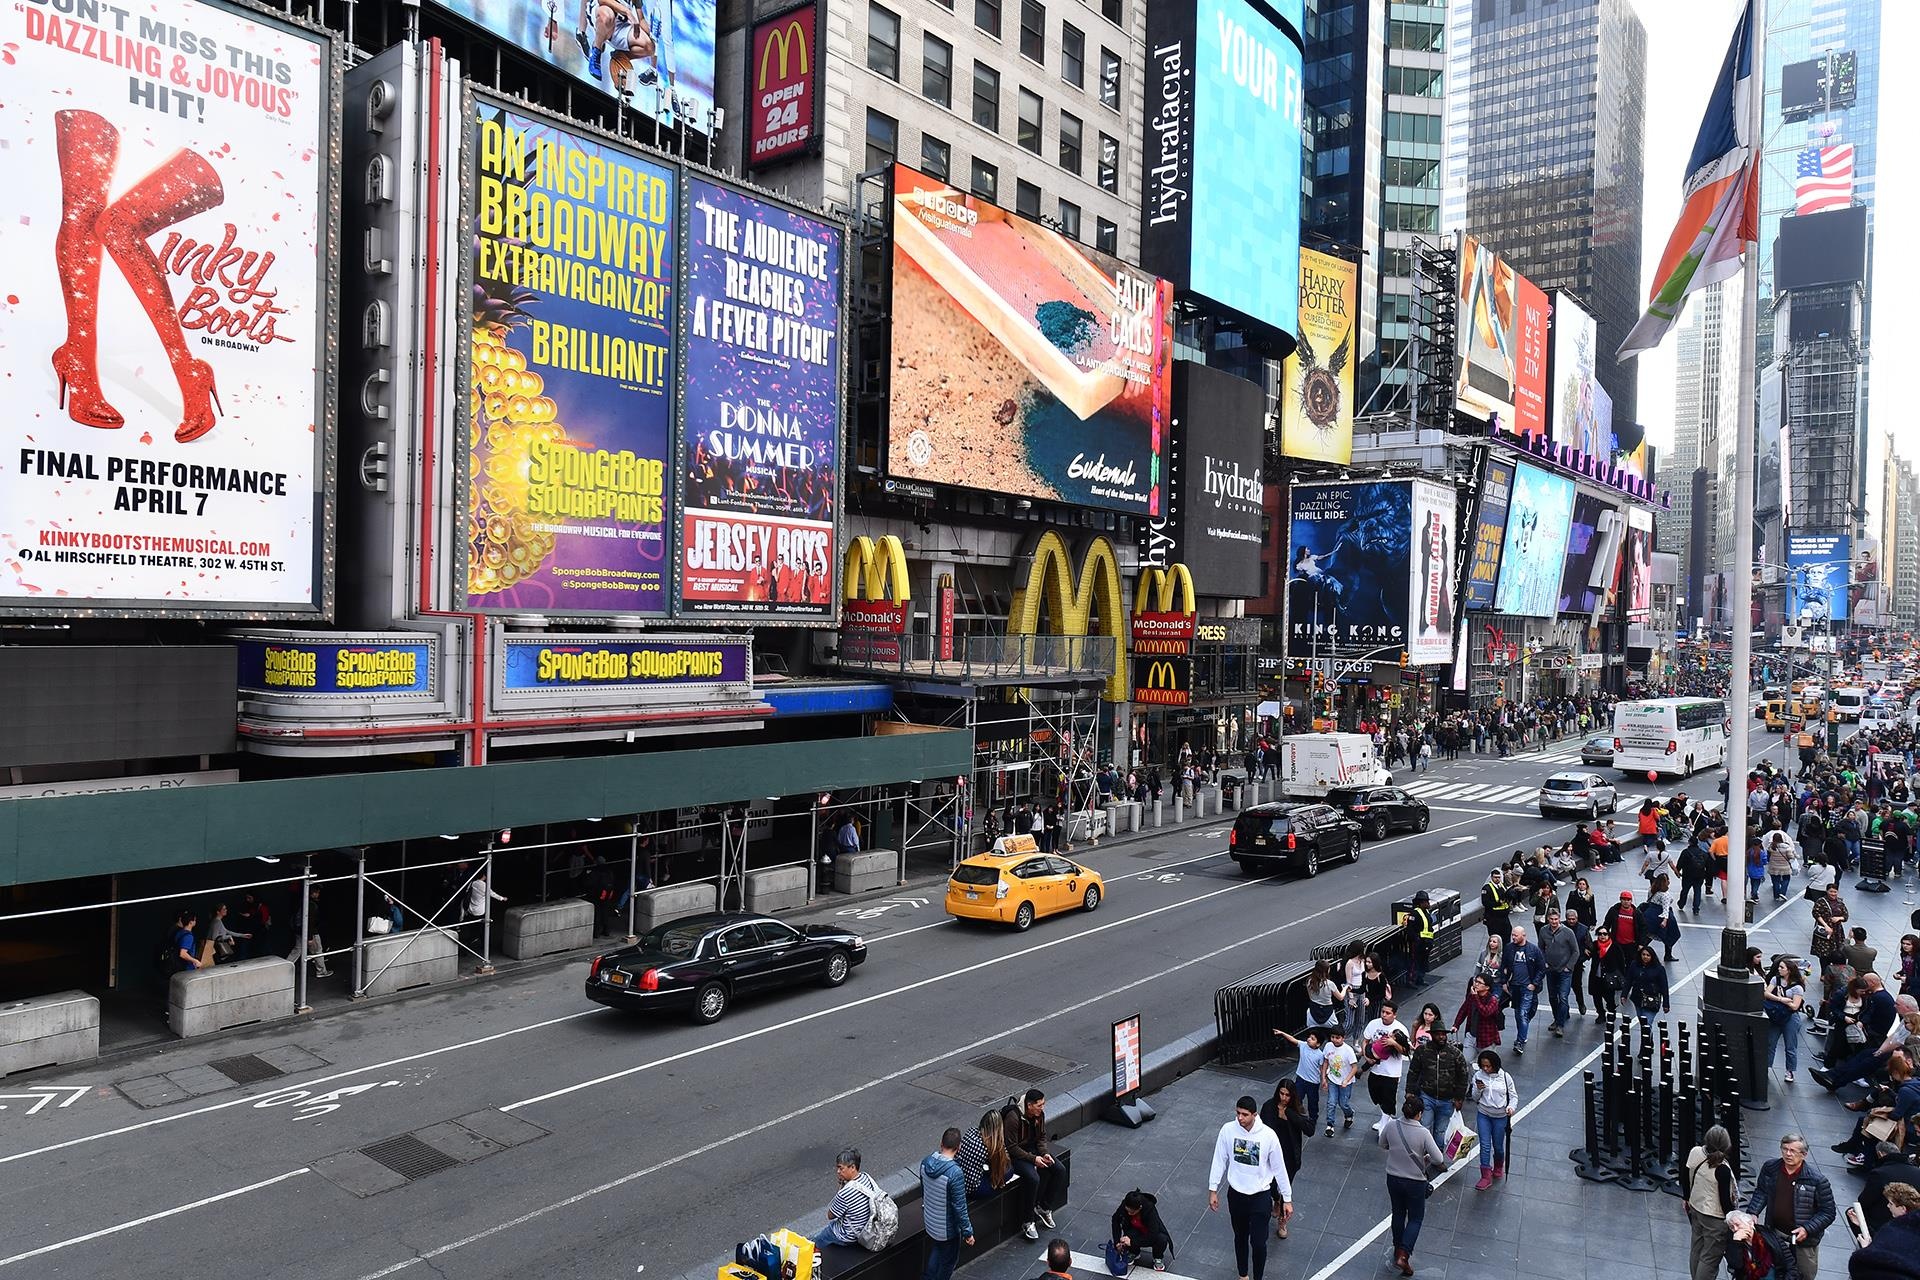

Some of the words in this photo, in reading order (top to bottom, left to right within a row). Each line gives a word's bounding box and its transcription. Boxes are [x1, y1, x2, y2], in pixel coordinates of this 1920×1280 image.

[140, 16, 217, 60] MISS
[226, 44, 291, 84] THIS
[1217, 8, 1278, 112] YOUR
[170, 55, 191, 88] &
[130, 76, 205, 124] HIT!
[762, 81, 804, 108] OPEN
[766, 100, 799, 133] 24
[756, 124, 808, 154] HOURS
[1150, 40, 1188, 227] hydrafacial
[1182, 89, 1190, 178] COMPANY
[535, 137, 666, 226] INSPIRED
[1150, 182, 1158, 215] THE
[480, 176, 666, 278] BROADWAY
[743, 219, 828, 282] AUDIENCE
[360, 80, 394, 492] PALACE
[724, 257, 806, 318] REACHES
[1116, 270, 1156, 318] FAITH
[1302, 267, 1345, 298] HARRY
[178, 284, 296, 344] Boots
[1299, 286, 1348, 318] POTTER
[692, 296, 706, 338] A
[712, 300, 768, 352] FEVER
[1110, 311, 1154, 357] CALLS
[1304, 312, 1325, 324] CURSED
[1326, 318, 1342, 330] CHILD
[201, 336, 213, 345] ON
[214, 338, 260, 353] BROADWAY
[757, 398, 772, 408] THE
[720, 401, 804, 442] DONNA
[707, 430, 815, 472] SUMMER
[1212, 458, 1231, 470] THE
[20, 448, 100, 480] FINAL
[108, 456, 287, 497] PERFORMANCE
[746, 466, 777, 478] MUSICAL
[1066, 452, 1136, 486] Guatemala
[1170, 440, 1178, 527] COMPANY
[1578, 451, 1658, 503] BROADWAY
[114, 486, 188, 515] APRIL
[194, 493, 209, 516] 7
[1300, 500, 1340, 511] DAZZLING
[1330, 490, 1352, 500] EPIC.
[530, 522, 544, 531] THE
[544, 524, 582, 534] BROADWAY
[582, 524, 618, 538] MUSICAL
[618, 530, 630, 538] FOR
[1294, 511, 1322, 520] THRILL
[40, 530, 271, 557] KINKYBOOTSTHEMUSICAL.COM
[687, 520, 772, 572] JERSEY
[776, 527, 829, 577] BOYS
[35, 550, 52, 562] AL
[56, 551, 136, 566] HIRSCHFELD
[140, 555, 198, 570] THEATRE,
[200, 558, 222, 570] 302
[224, 559, 238, 570] W.
[240, 560, 268, 572] 45TH
[270, 562, 286, 572] ST.
[552, 567, 660, 580] SpongeBobBroadway.com
[562, 580, 640, 592] @SpongeBobBway
[692, 582, 710, 592] BEST
[710, 582, 739, 593] MUSICAL
[1430, 573, 1440, 627] WOMAN
[842, 611, 902, 624] McDonald's
[848, 624, 890, 634] Restaurant
[1134, 620, 1191, 629] McDonald's
[1294, 624, 1338, 635] KING
[1350, 625, 1402, 637] KONG
